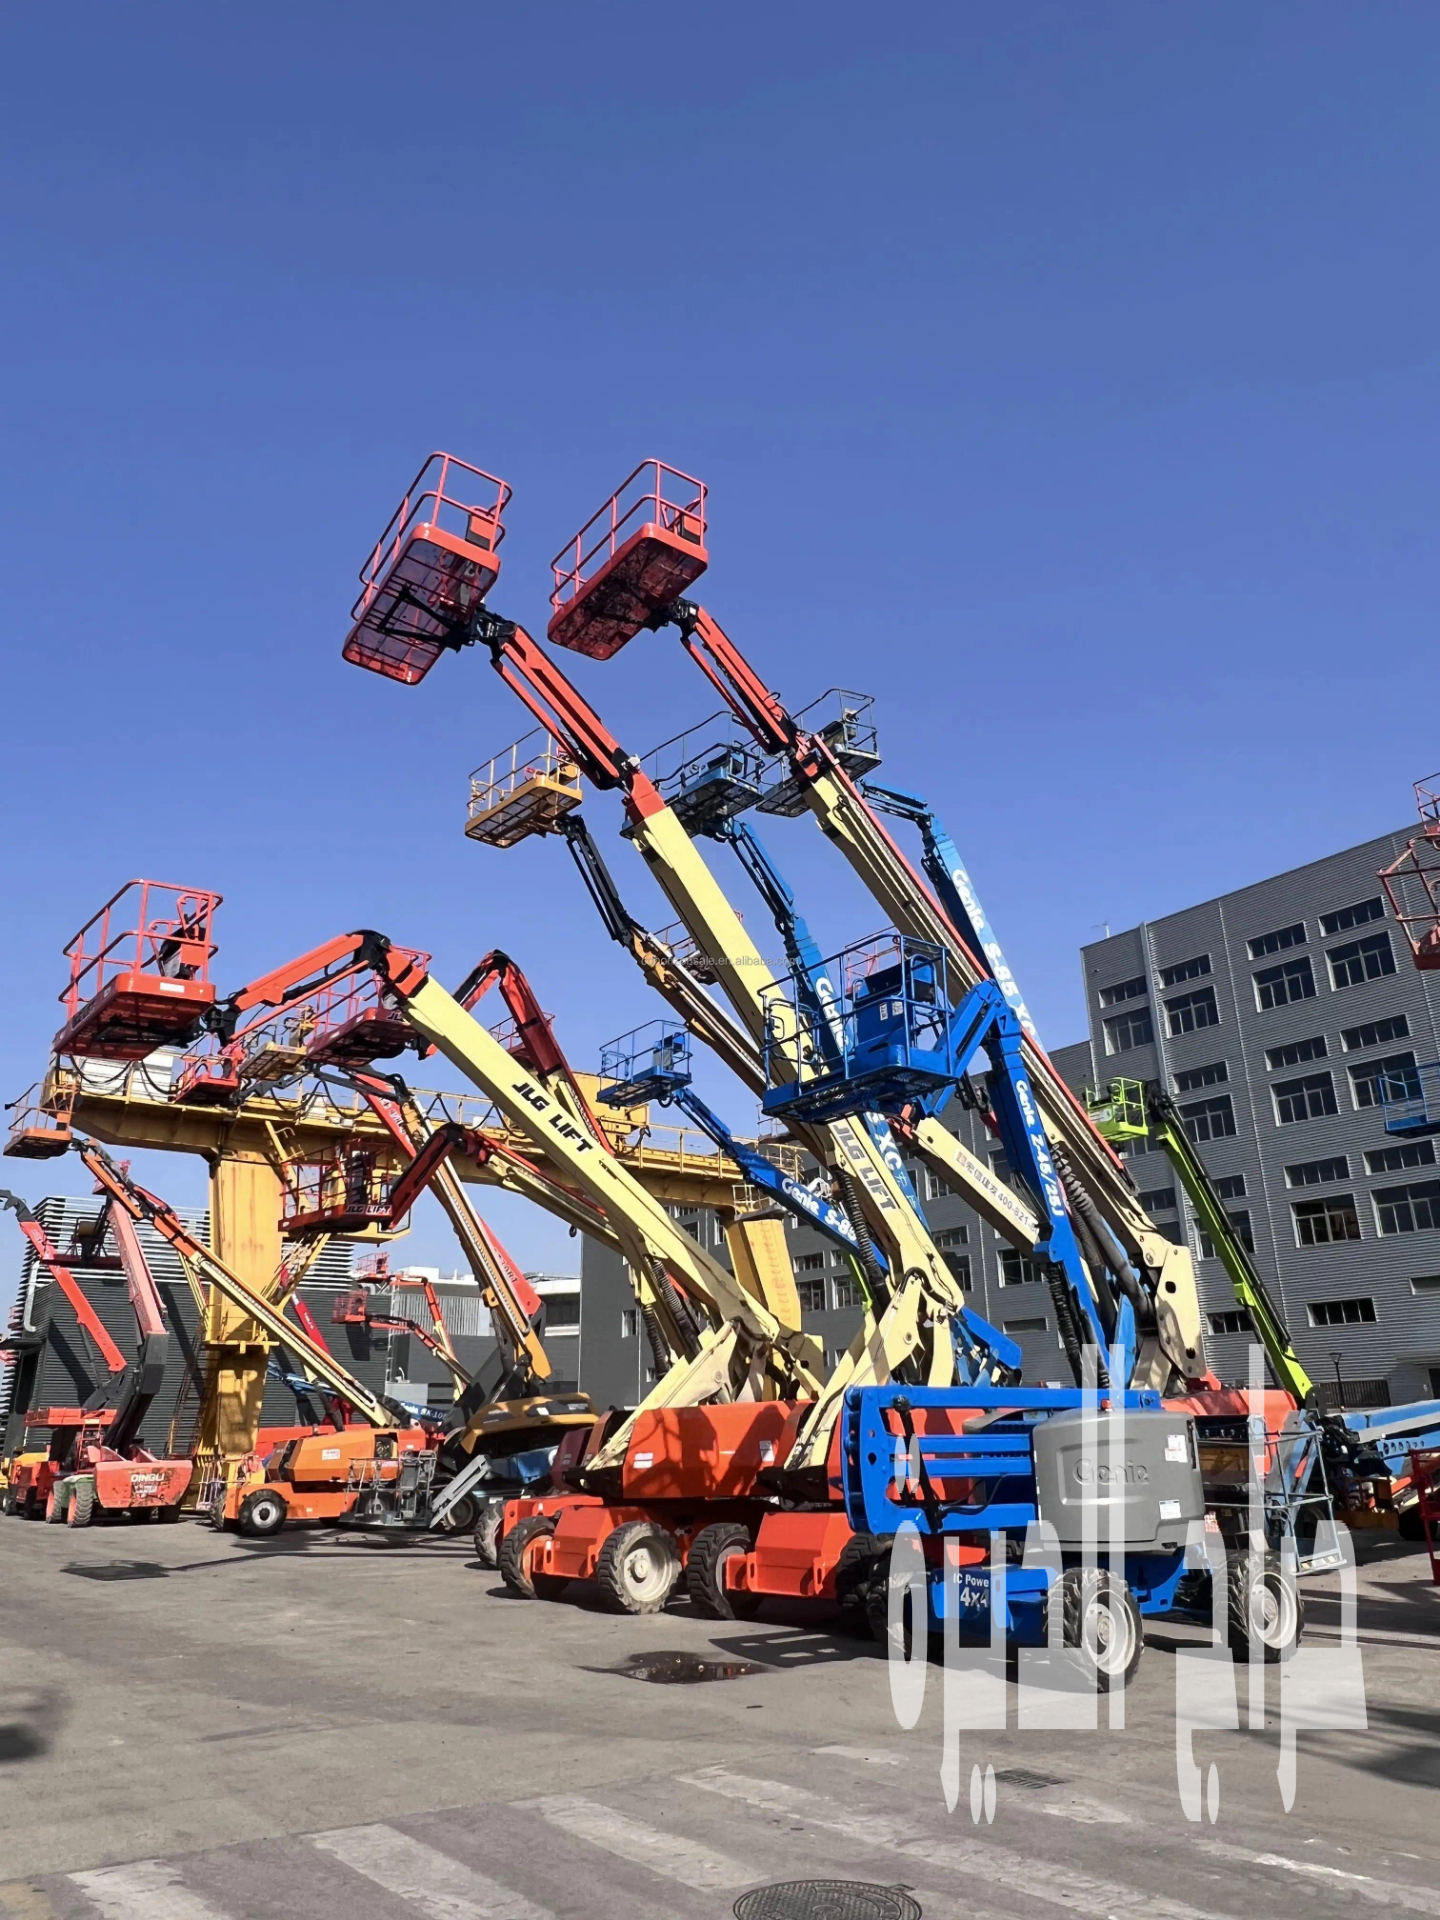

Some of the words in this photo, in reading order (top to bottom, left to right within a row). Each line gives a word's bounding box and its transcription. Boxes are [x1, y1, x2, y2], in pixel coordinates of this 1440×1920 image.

[952, 868, 985, 934] Genie
[983, 942, 1020, 997] S-85
[511, 1082, 551, 1112] JLG
[548, 1113, 593, 1152] LIFT
[832, 1124, 866, 1160] JLG
[859, 1166, 897, 1210] LIFT
[1015, 1079, 1036, 1128] Genie
[1030, 1133, 1065, 1217] Z-45/25J
[366, 1204, 391, 1214] LIFT
[781, 1177, 820, 1216] Genie
[1072, 1459, 1151, 1486] Genie
[953, 1573, 963, 1584] IC
[960, 1587, 990, 1608] 4x4
